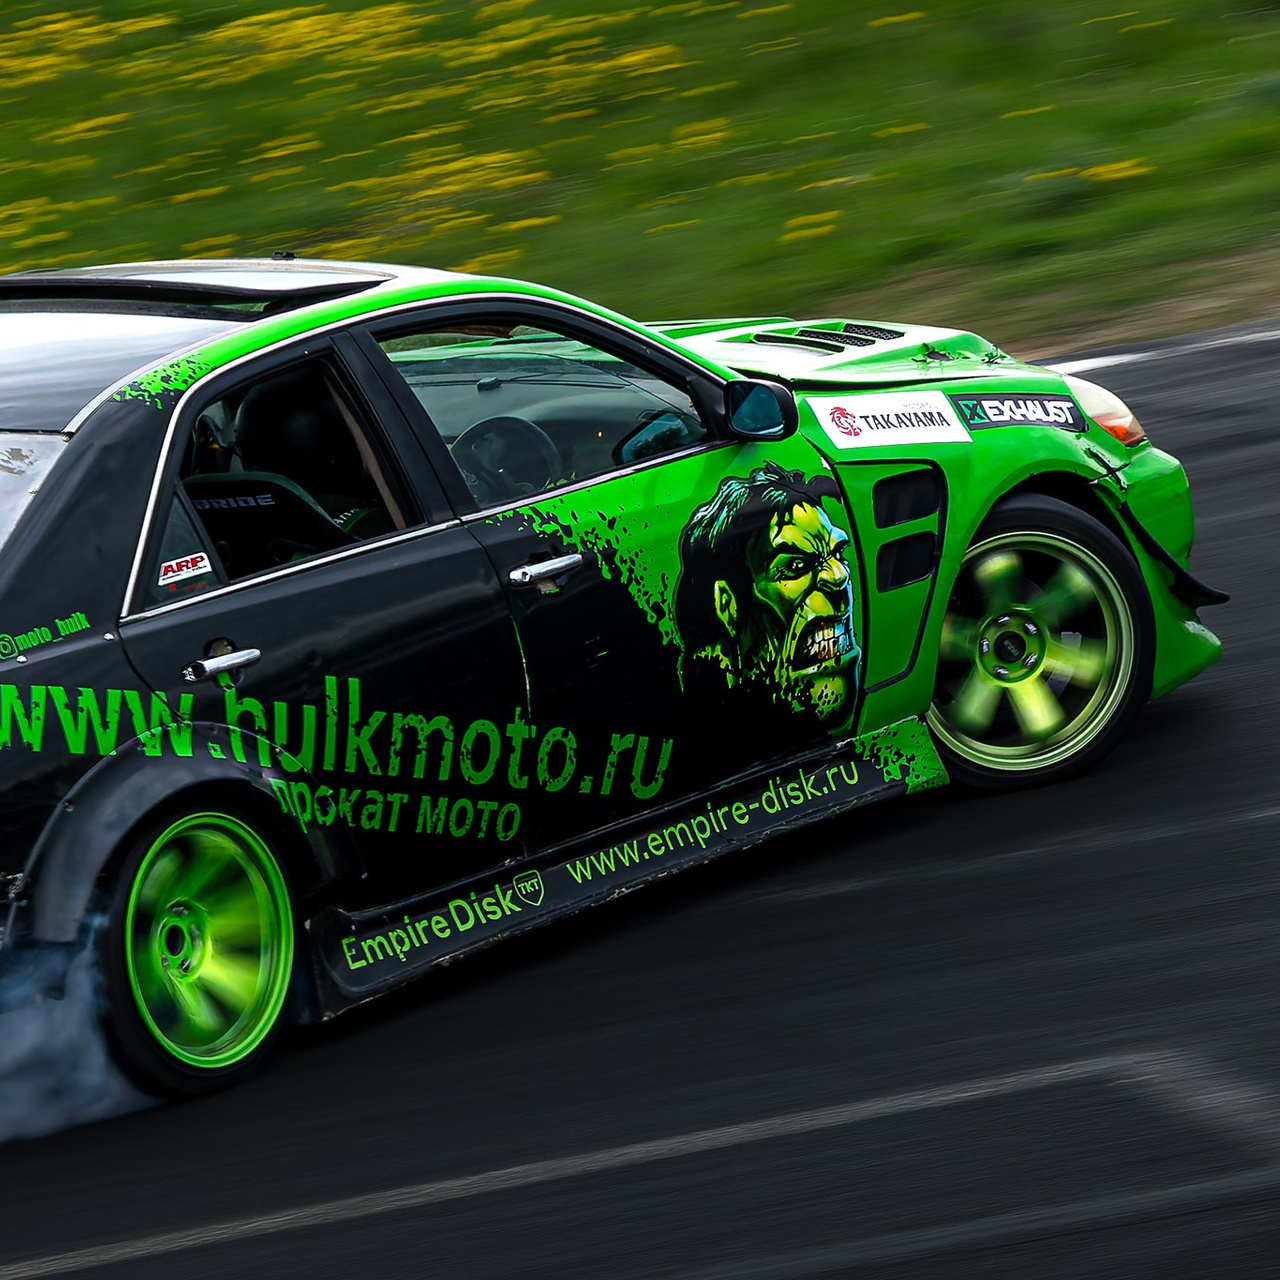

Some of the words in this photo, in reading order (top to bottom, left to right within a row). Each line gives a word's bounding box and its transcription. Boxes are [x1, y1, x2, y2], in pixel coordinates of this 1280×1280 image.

[859, 410, 952, 431] TAKAYAMA
[983, 399, 1075, 425] EXHAUST
[162, 555, 206, 576] ARP
[13, 611, 91, 651] moto_hulk
[341, 916, 451, 971] Empire
[449, 883, 522, 933] Disk
[517, 878, 540, 895] TKT
[566, 757, 860, 885] www.empire-disk.ru
